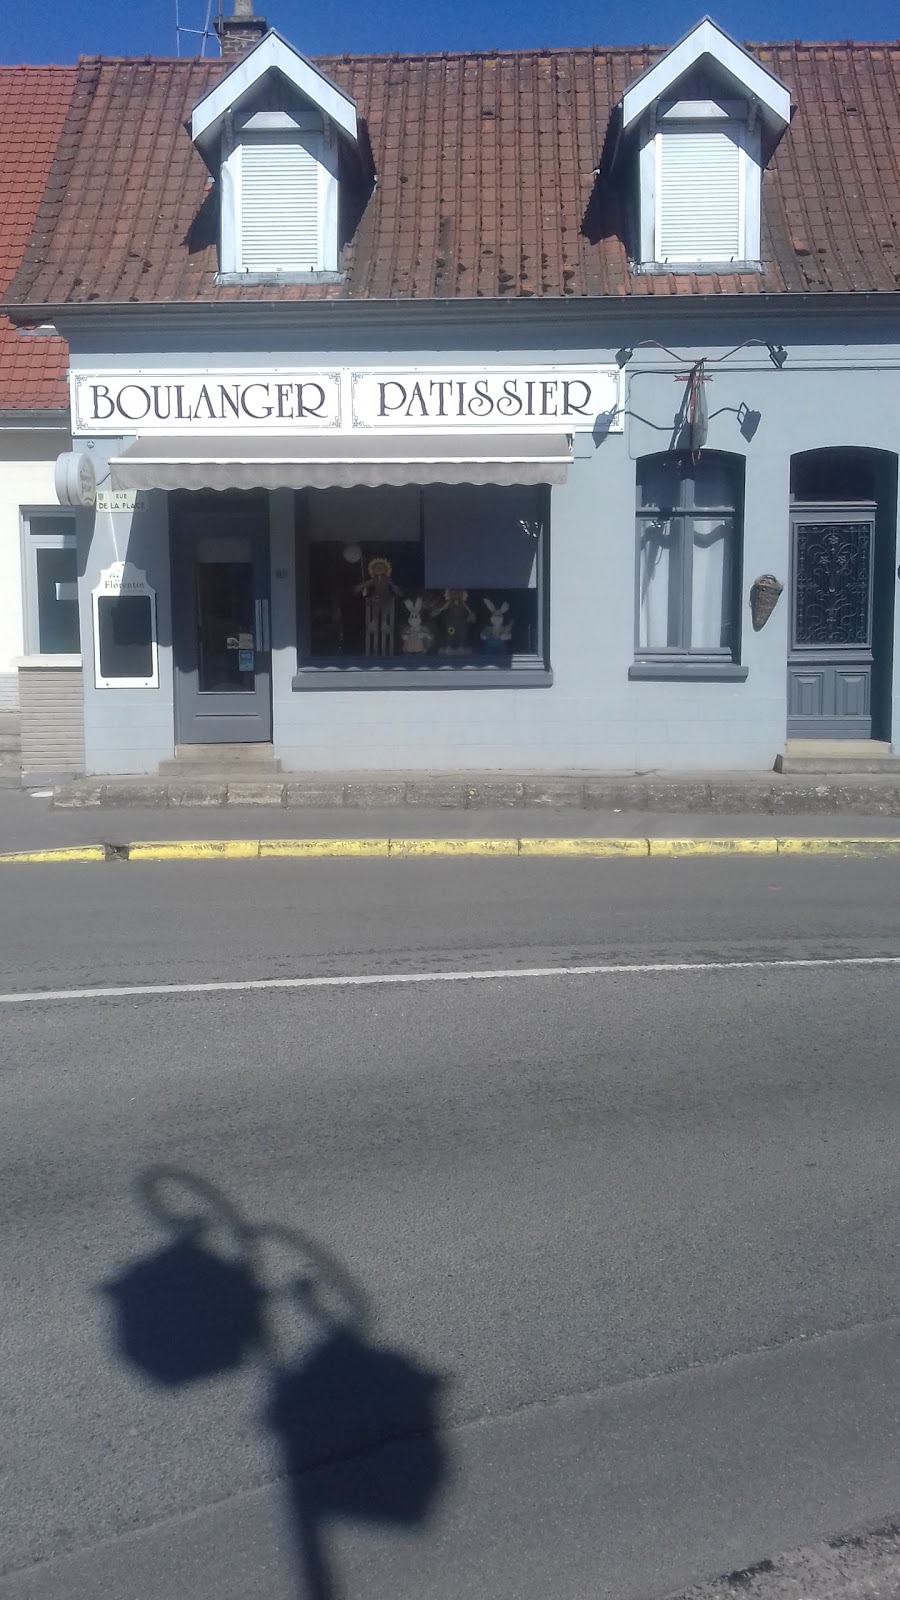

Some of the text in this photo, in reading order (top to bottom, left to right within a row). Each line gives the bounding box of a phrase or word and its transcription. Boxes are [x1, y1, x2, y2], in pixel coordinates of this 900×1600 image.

[89, 379, 595, 421] BOULANGER PATISSIER
[104, 580, 145, 589] Florentin
